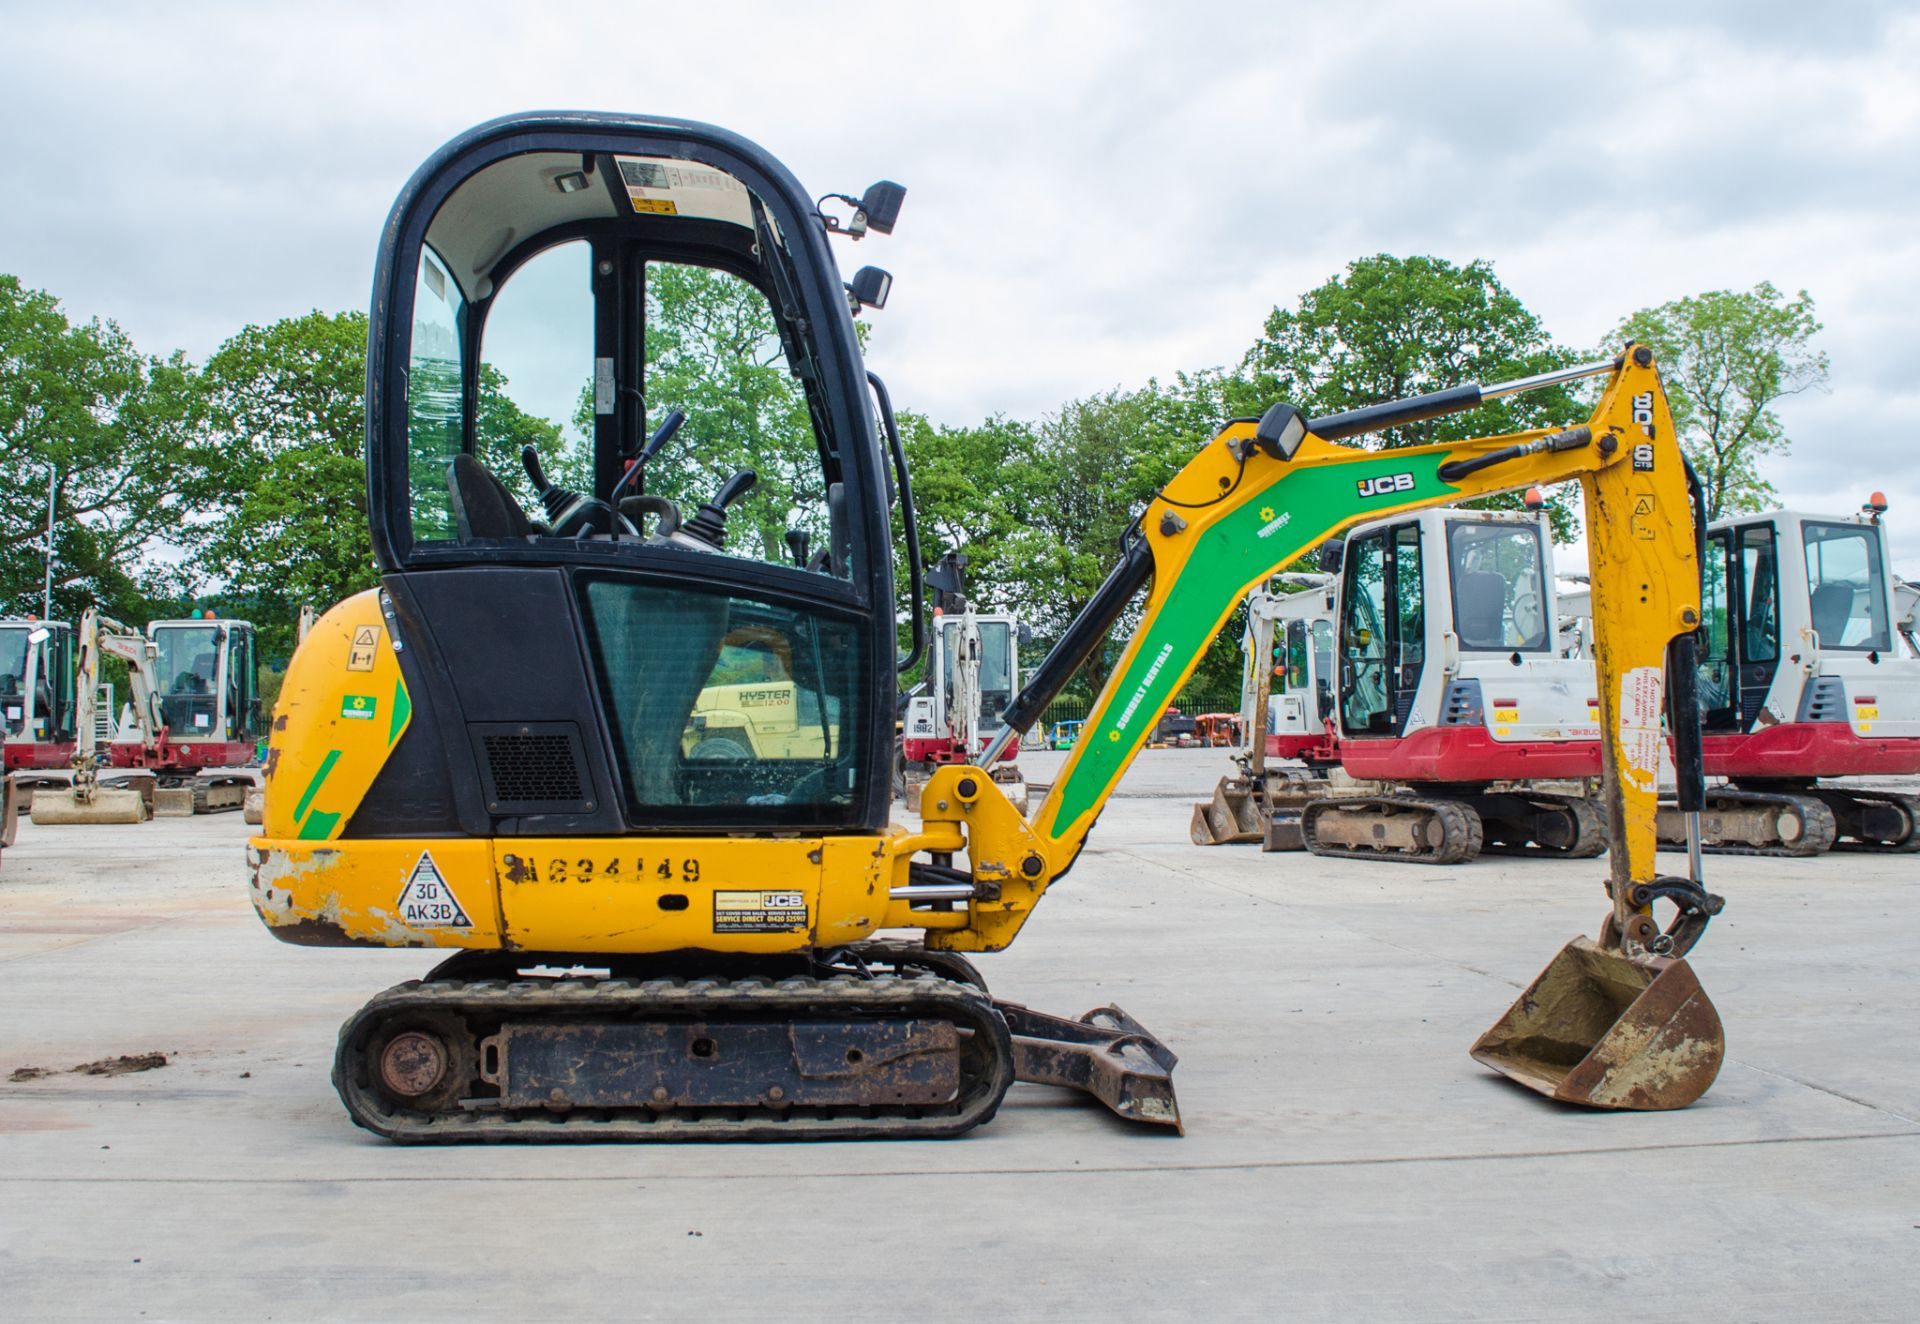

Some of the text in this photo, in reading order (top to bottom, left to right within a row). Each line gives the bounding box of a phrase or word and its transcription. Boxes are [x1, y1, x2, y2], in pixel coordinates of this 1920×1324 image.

[1357, 473, 1415, 497] JCB
[1116, 643, 1173, 730] SUNBELT RENTALS
[1650, 676, 1656, 687] DO
[738, 689, 791, 701] HYSTER
[763, 894, 804, 907] JCB
[407, 904, 452, 920] AK3B
[716, 915, 740, 923] SERVICE
[741, 915, 765, 923] DIRECT
